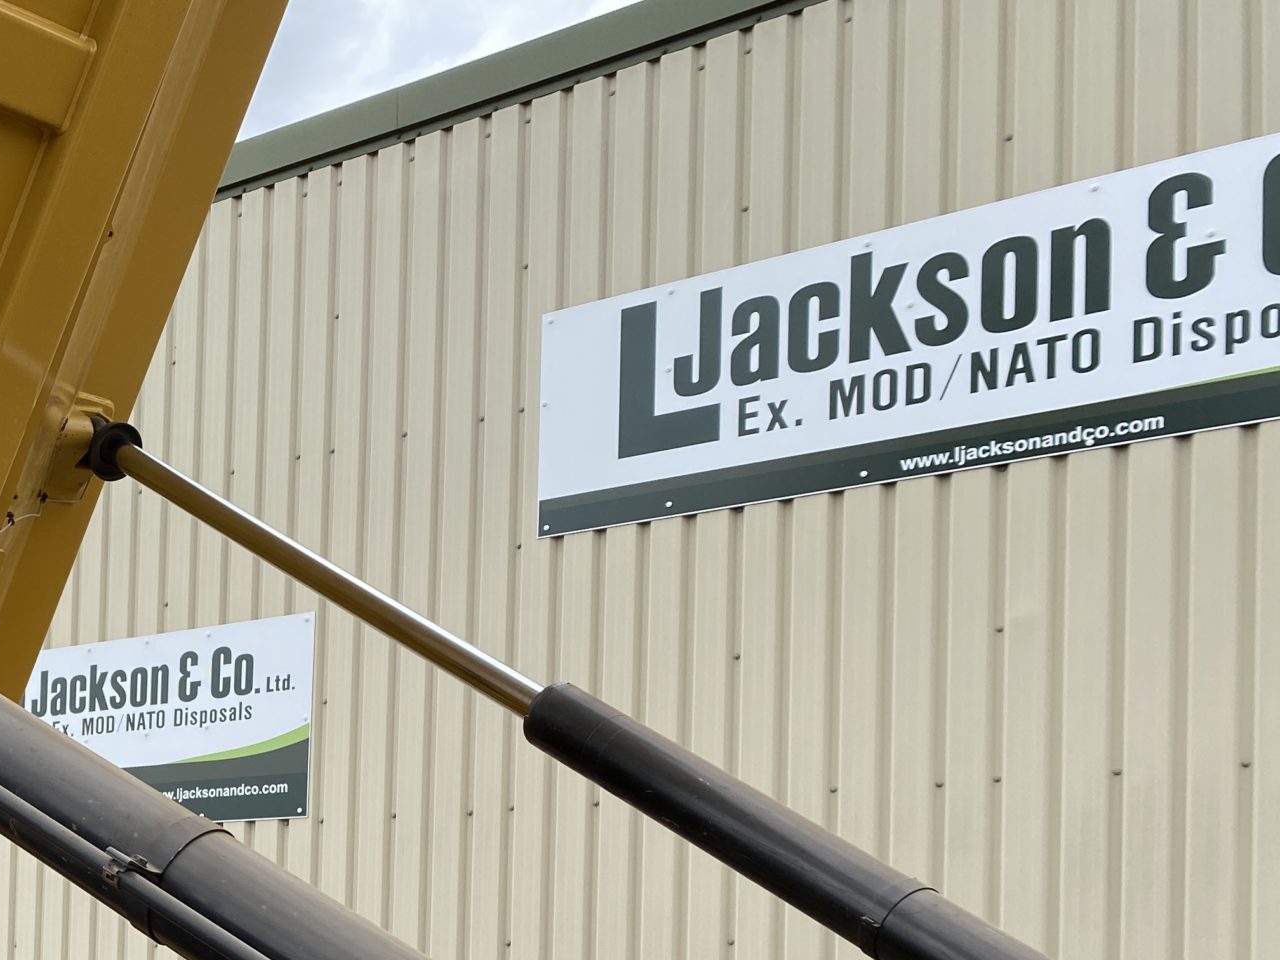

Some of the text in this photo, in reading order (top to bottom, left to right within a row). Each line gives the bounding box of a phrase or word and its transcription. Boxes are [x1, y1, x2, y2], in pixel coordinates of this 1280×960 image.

[1145, 171, 1228, 300] &
[737, 394, 803, 437] Ex.
[829, 327, 1101, 420] MOD/NATO
[900, 415, 1166, 471] www.ljacksonandco.com
[23, 646, 296, 718] Jackson & Co. Ltd.
[81, 709, 166, 737] MOD/NATO
[173, 701, 253, 728] Disposals
[162, 782, 289, 803] w.ljacksonandco.com
